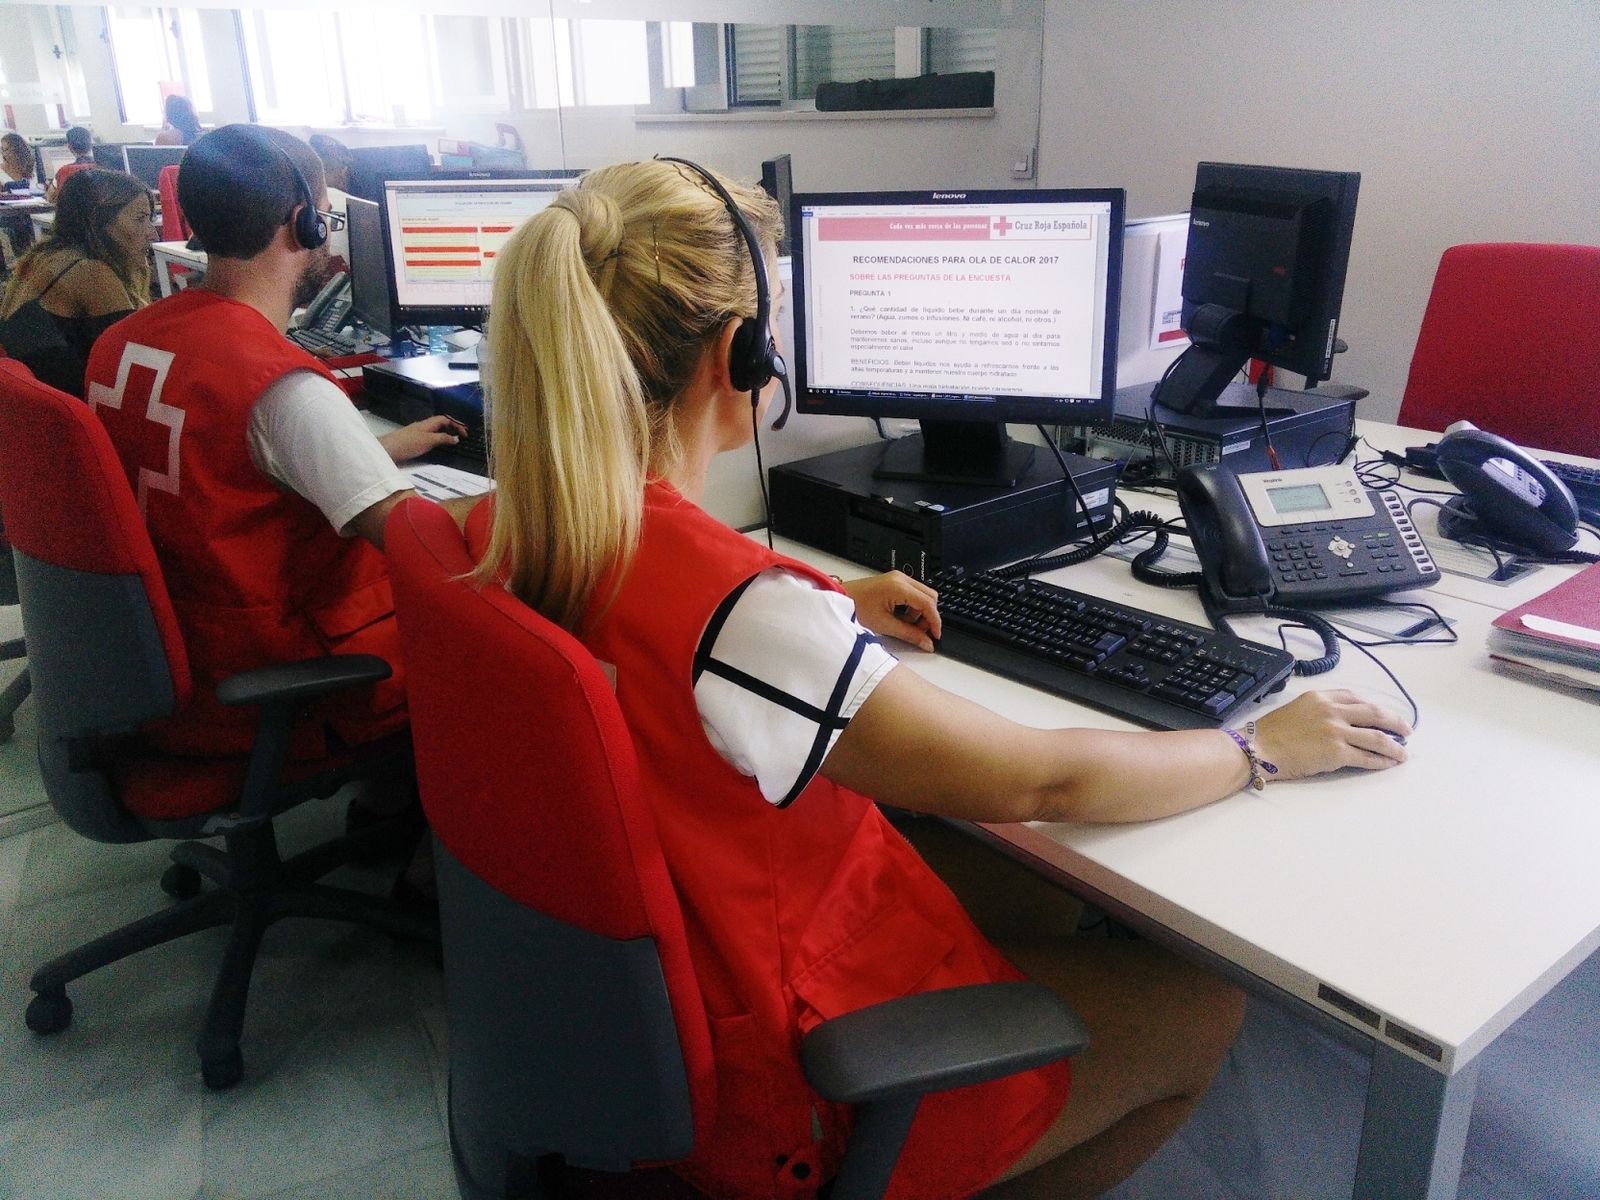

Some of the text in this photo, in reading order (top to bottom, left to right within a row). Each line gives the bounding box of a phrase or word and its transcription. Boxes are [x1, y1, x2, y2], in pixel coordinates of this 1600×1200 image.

[1014, 220, 1087, 231] Cruz Roja Española
[852, 255, 1060, 264] RECOMENDACIONES PARA OLA DE CALOR 2017
[849, 273, 1011, 282] SOBRE LAS PREGUNTAS DE LA ENCUESTA
[849, 289, 886, 297] PREGUNTA
[859, 305, 877, 313] ¿Qué
[879, 305, 908, 313] cantidad
[969, 330, 988, 338] medio
[1003, 332, 1019, 340] agua
[1022, 331, 1029, 339] al
[1046, 333, 1062, 341] para
[850, 343, 892, 351] especialmente
